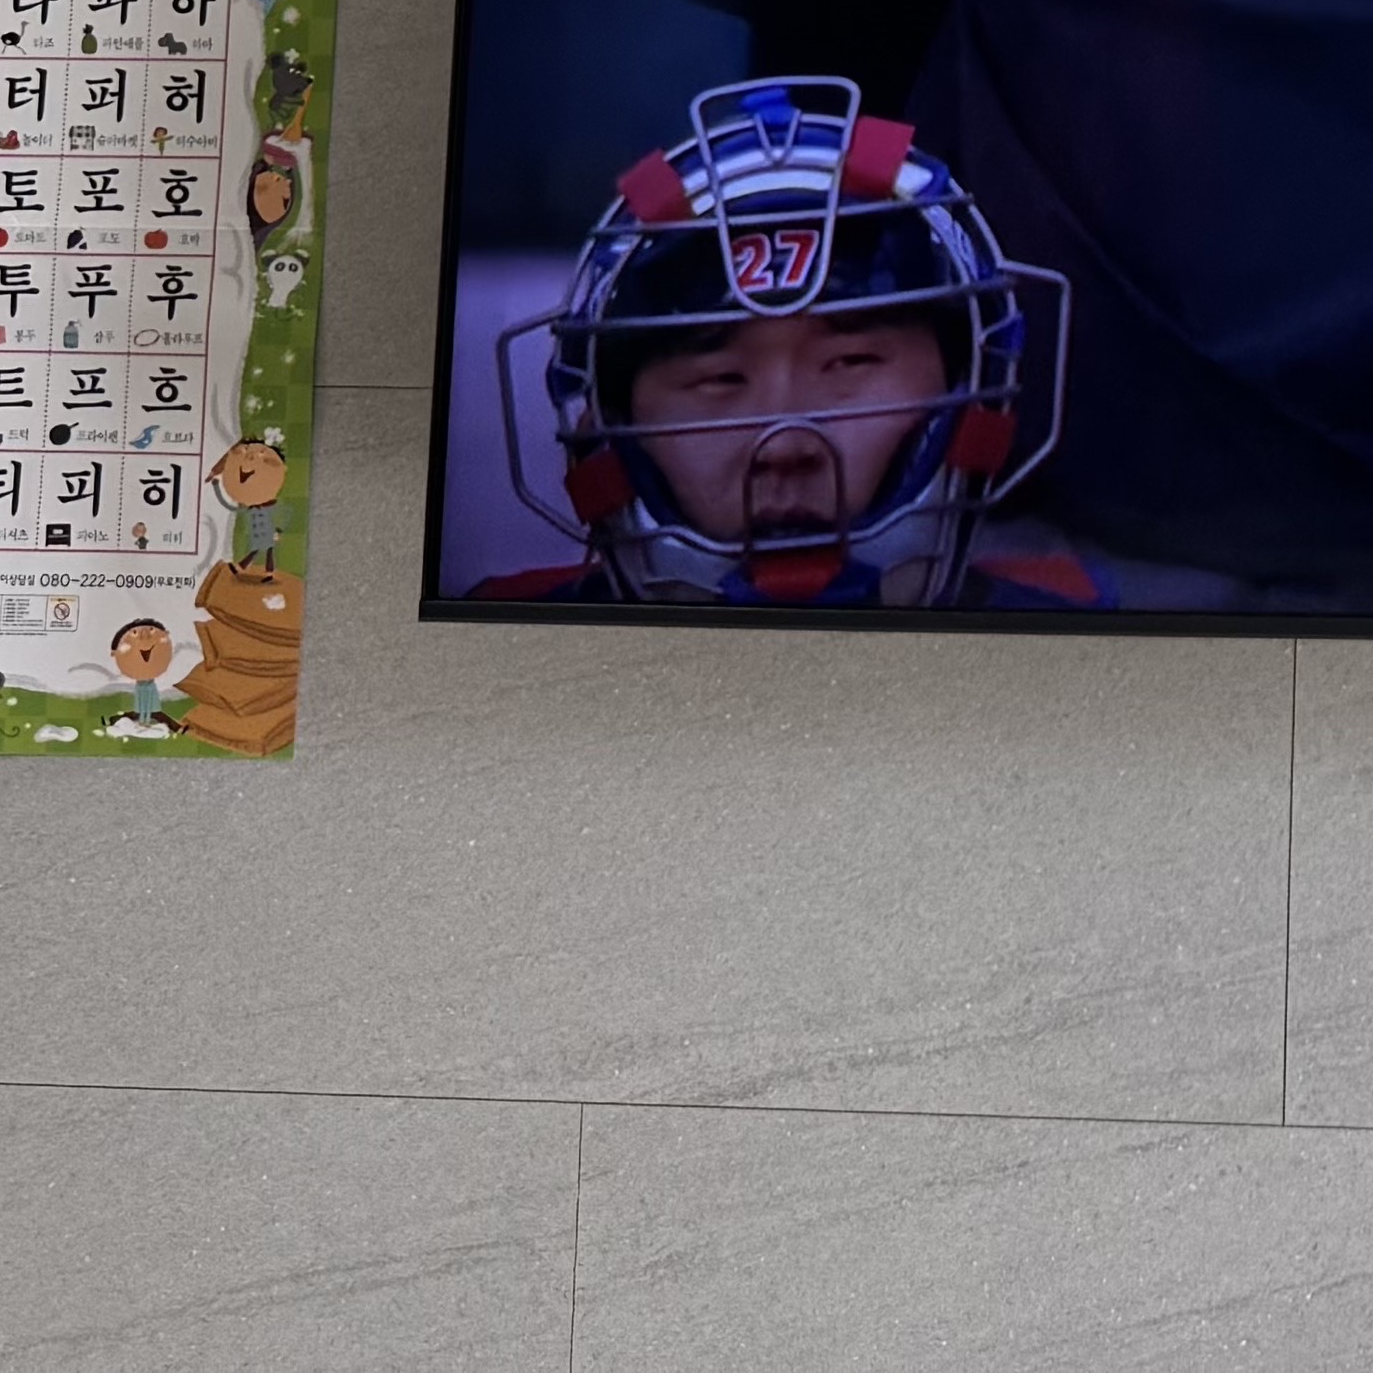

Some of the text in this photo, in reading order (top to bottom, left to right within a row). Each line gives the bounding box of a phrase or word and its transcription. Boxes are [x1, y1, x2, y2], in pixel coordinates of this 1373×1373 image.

[5, 67, 47, 122] 터
[81, 68, 127, 123] 퍼
[162, 69, 206, 124] 허
[0, 170, 45, 212] 토
[74, 168, 125, 213] 포
[151, 169, 203, 218] 호
[733, 231, 820, 291] 27
[0, 264, 40, 318] 투
[68, 264, 118, 319] 푸
[147, 265, 198, 321] 후
[62, 367, 113, 410] 프
[141, 366, 192, 412] 흐
[57, 461, 103, 518] 피
[139, 463, 182, 520] 히
